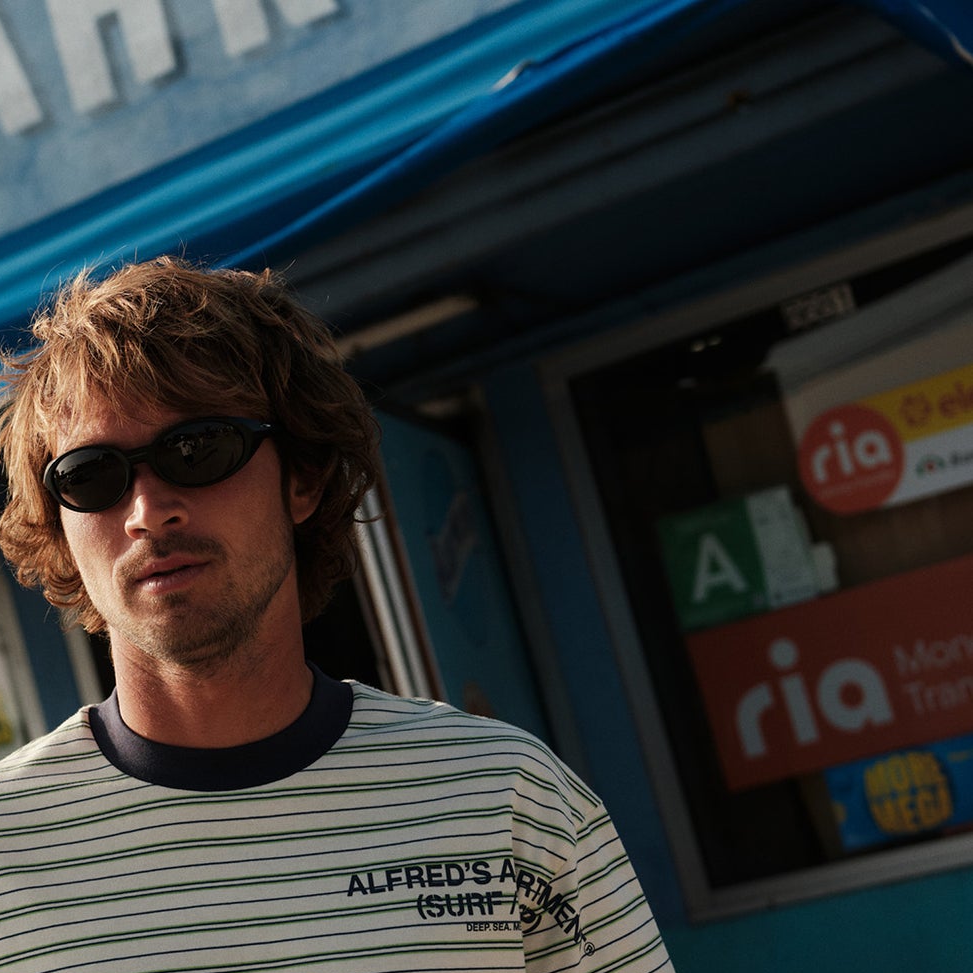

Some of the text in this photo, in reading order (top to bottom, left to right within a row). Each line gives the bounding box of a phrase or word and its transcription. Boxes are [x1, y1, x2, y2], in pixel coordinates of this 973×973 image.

[810, 420, 892, 485] ria
[691, 532, 748, 603] A
[735, 637, 894, 760] ria
[347, 860, 493, 897] ALFRED'S
